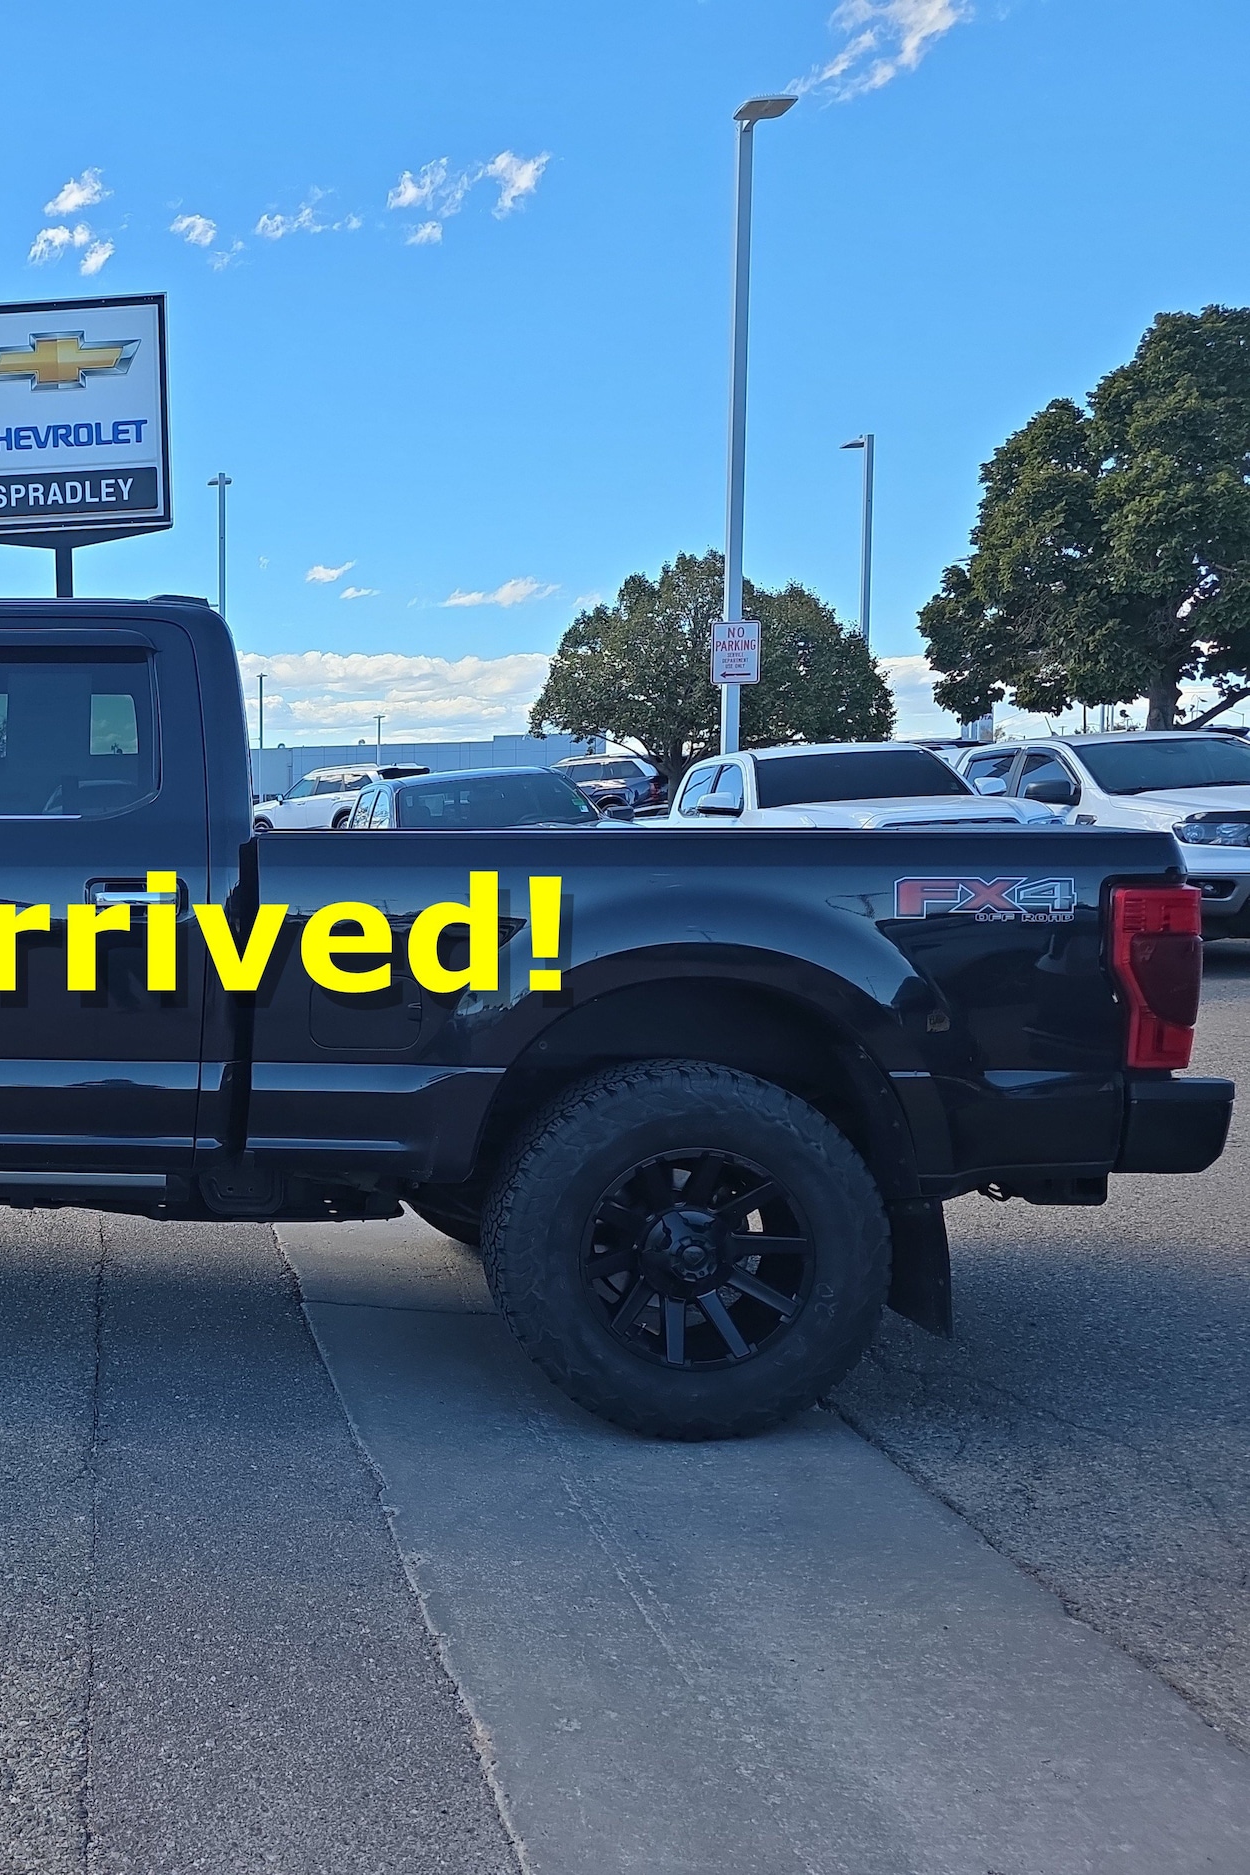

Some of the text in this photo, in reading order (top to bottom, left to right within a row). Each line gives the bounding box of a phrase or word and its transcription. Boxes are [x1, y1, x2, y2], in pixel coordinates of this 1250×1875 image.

[727, 626, 745, 638] NO
[715, 639, 756, 652] PARKING
[894, 876, 1078, 920] FX4
[974, 912, 1075, 923] OFF ROAD
